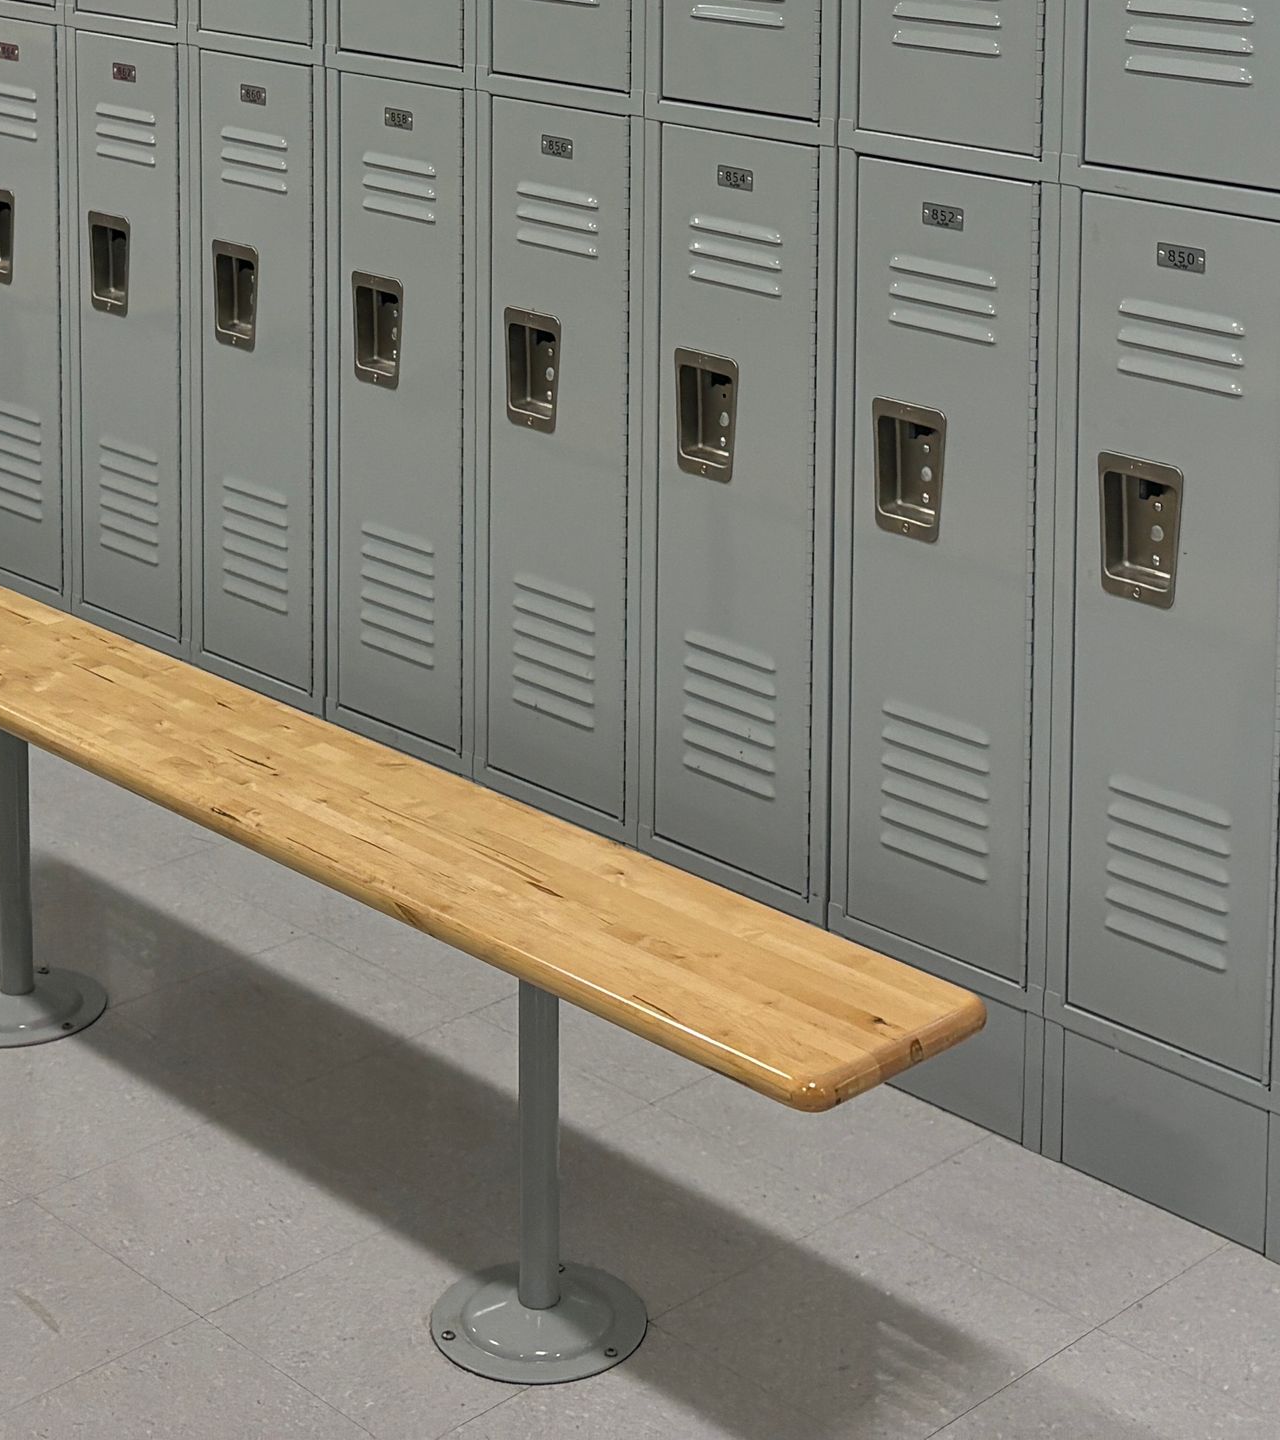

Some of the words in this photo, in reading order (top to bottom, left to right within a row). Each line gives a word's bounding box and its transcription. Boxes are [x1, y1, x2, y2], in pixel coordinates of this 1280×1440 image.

[246, 89, 261, 100] 860
[390, 111, 407, 124] 858
[548, 139, 567, 153] 856
[725, 170, 746, 184] 854
[931, 208, 955, 224] 852
[1167, 249, 1195, 265] 850
